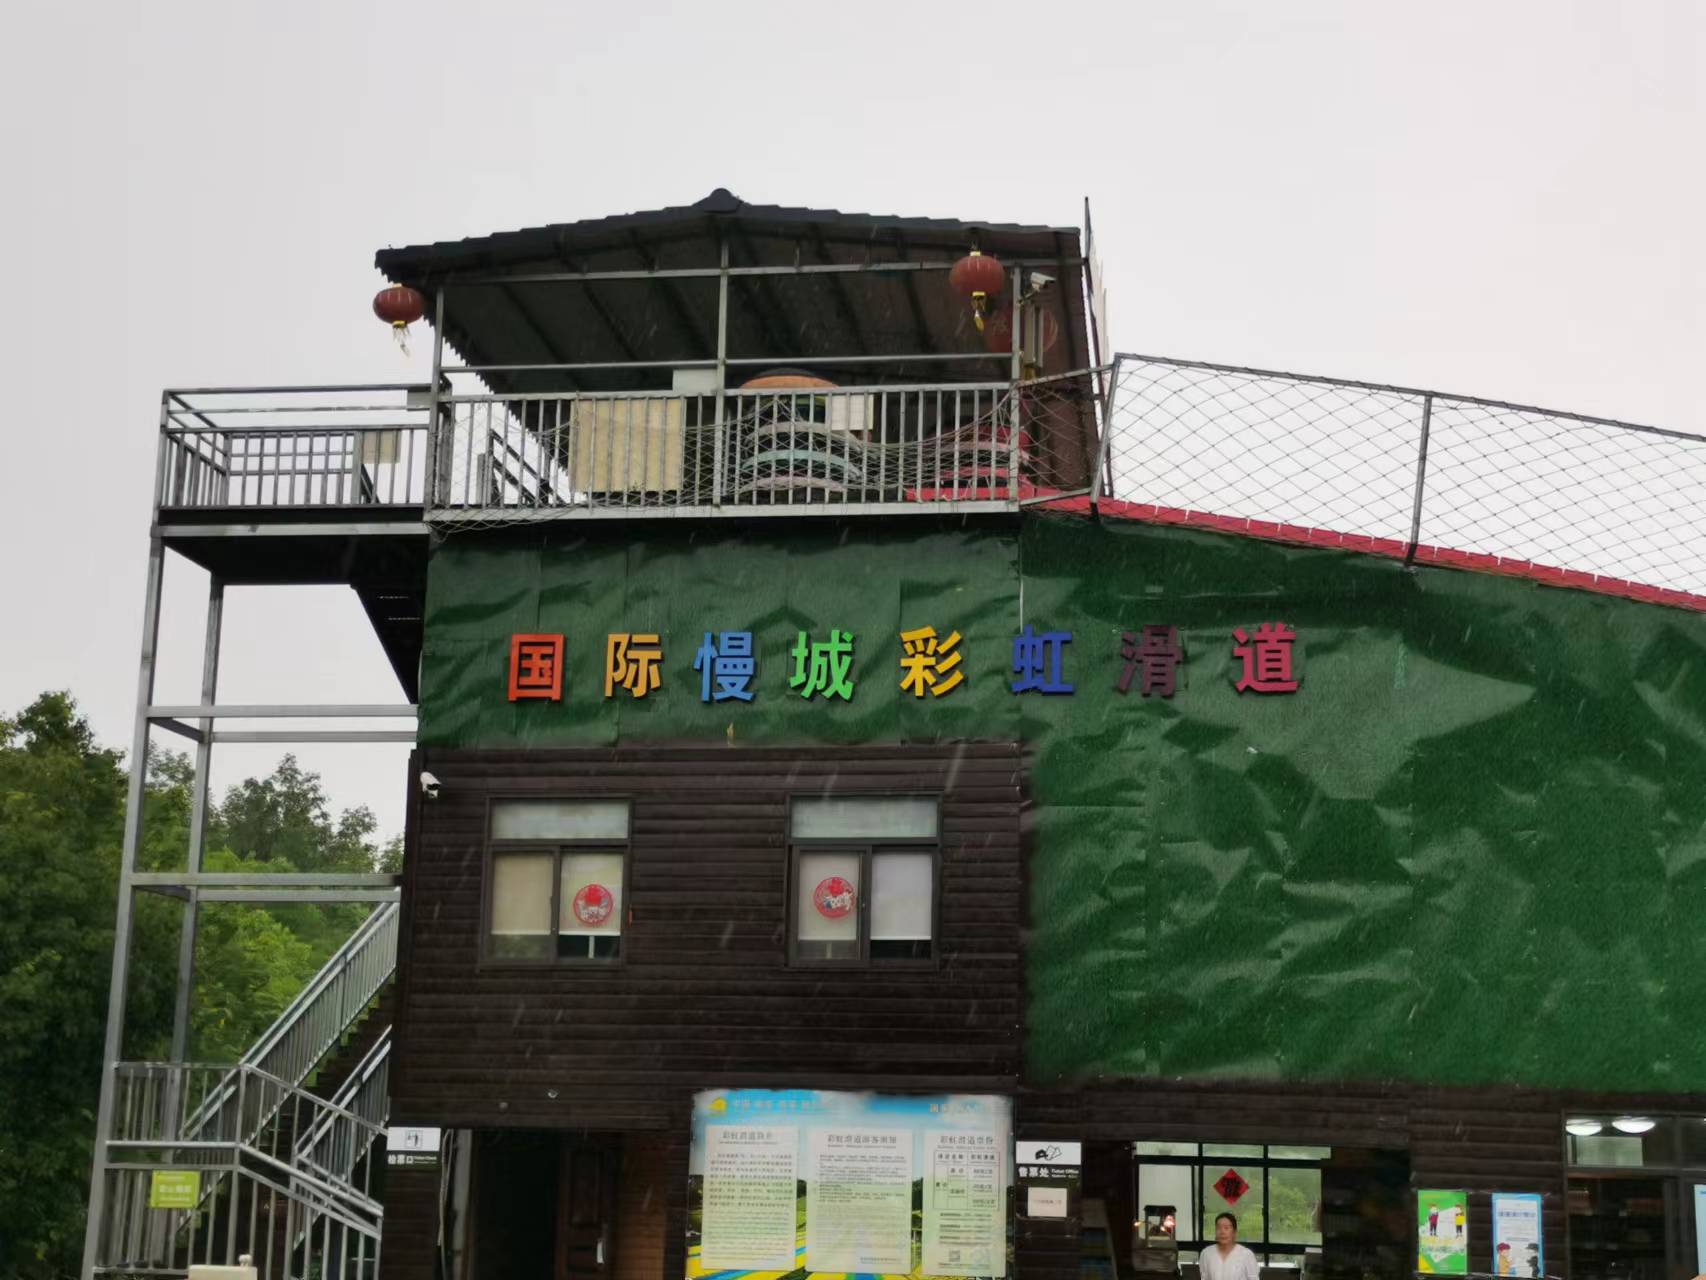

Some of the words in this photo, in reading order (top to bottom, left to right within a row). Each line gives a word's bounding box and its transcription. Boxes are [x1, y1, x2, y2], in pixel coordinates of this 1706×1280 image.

[507, 622, 1299, 703] 国际慢城彩虹滑道
